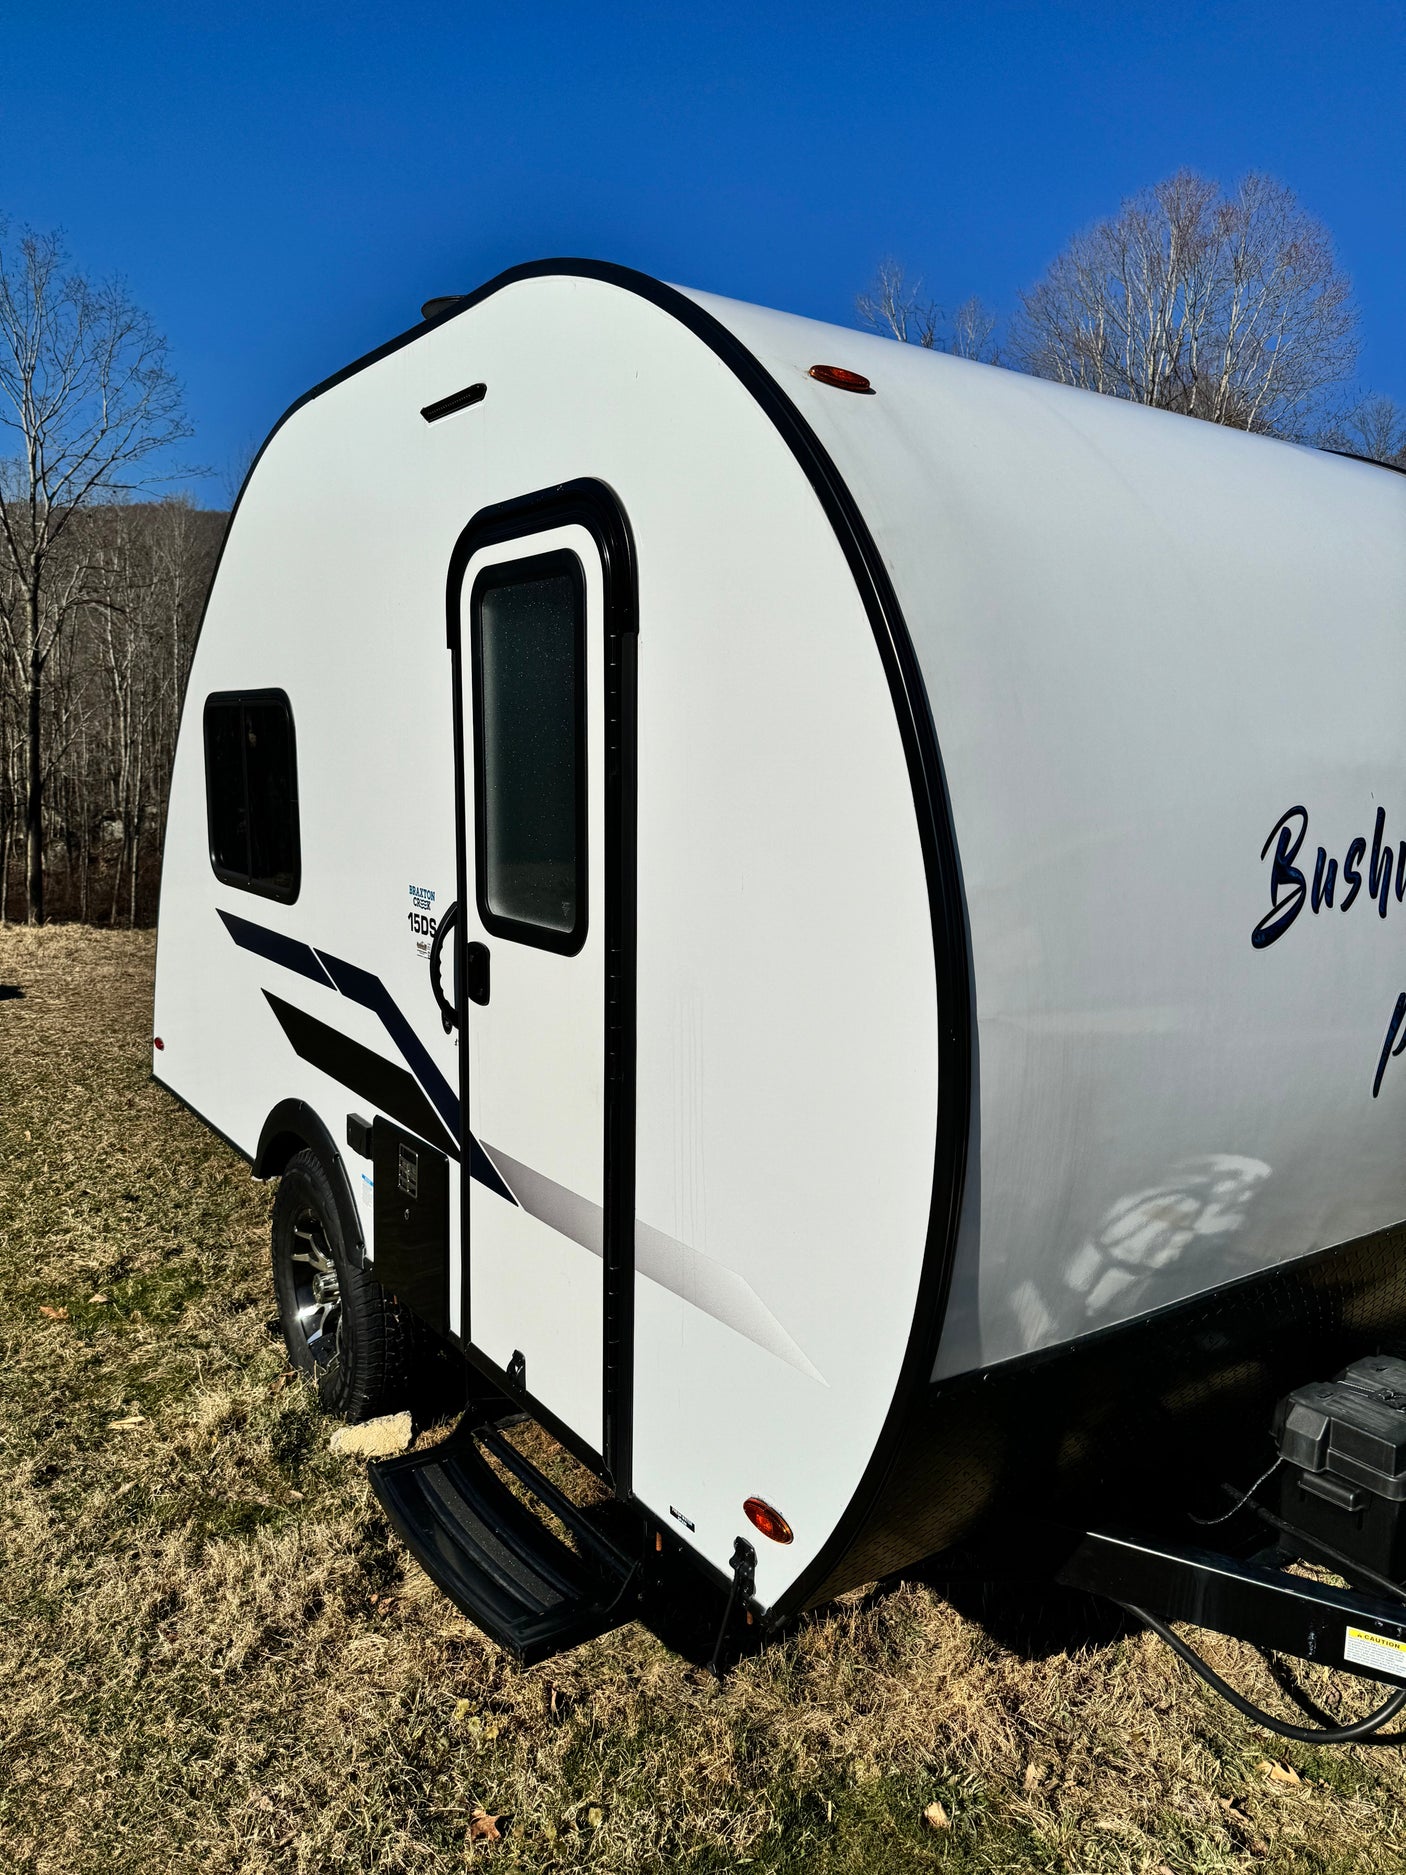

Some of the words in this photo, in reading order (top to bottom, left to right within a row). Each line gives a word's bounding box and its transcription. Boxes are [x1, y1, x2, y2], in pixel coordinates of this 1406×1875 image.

[409, 885, 435, 901] BRAXTON
[413, 897, 431, 911] CREEK
[408, 912, 437, 938] 15DS
[1364, 1634, 1400, 1649] CAUTION
